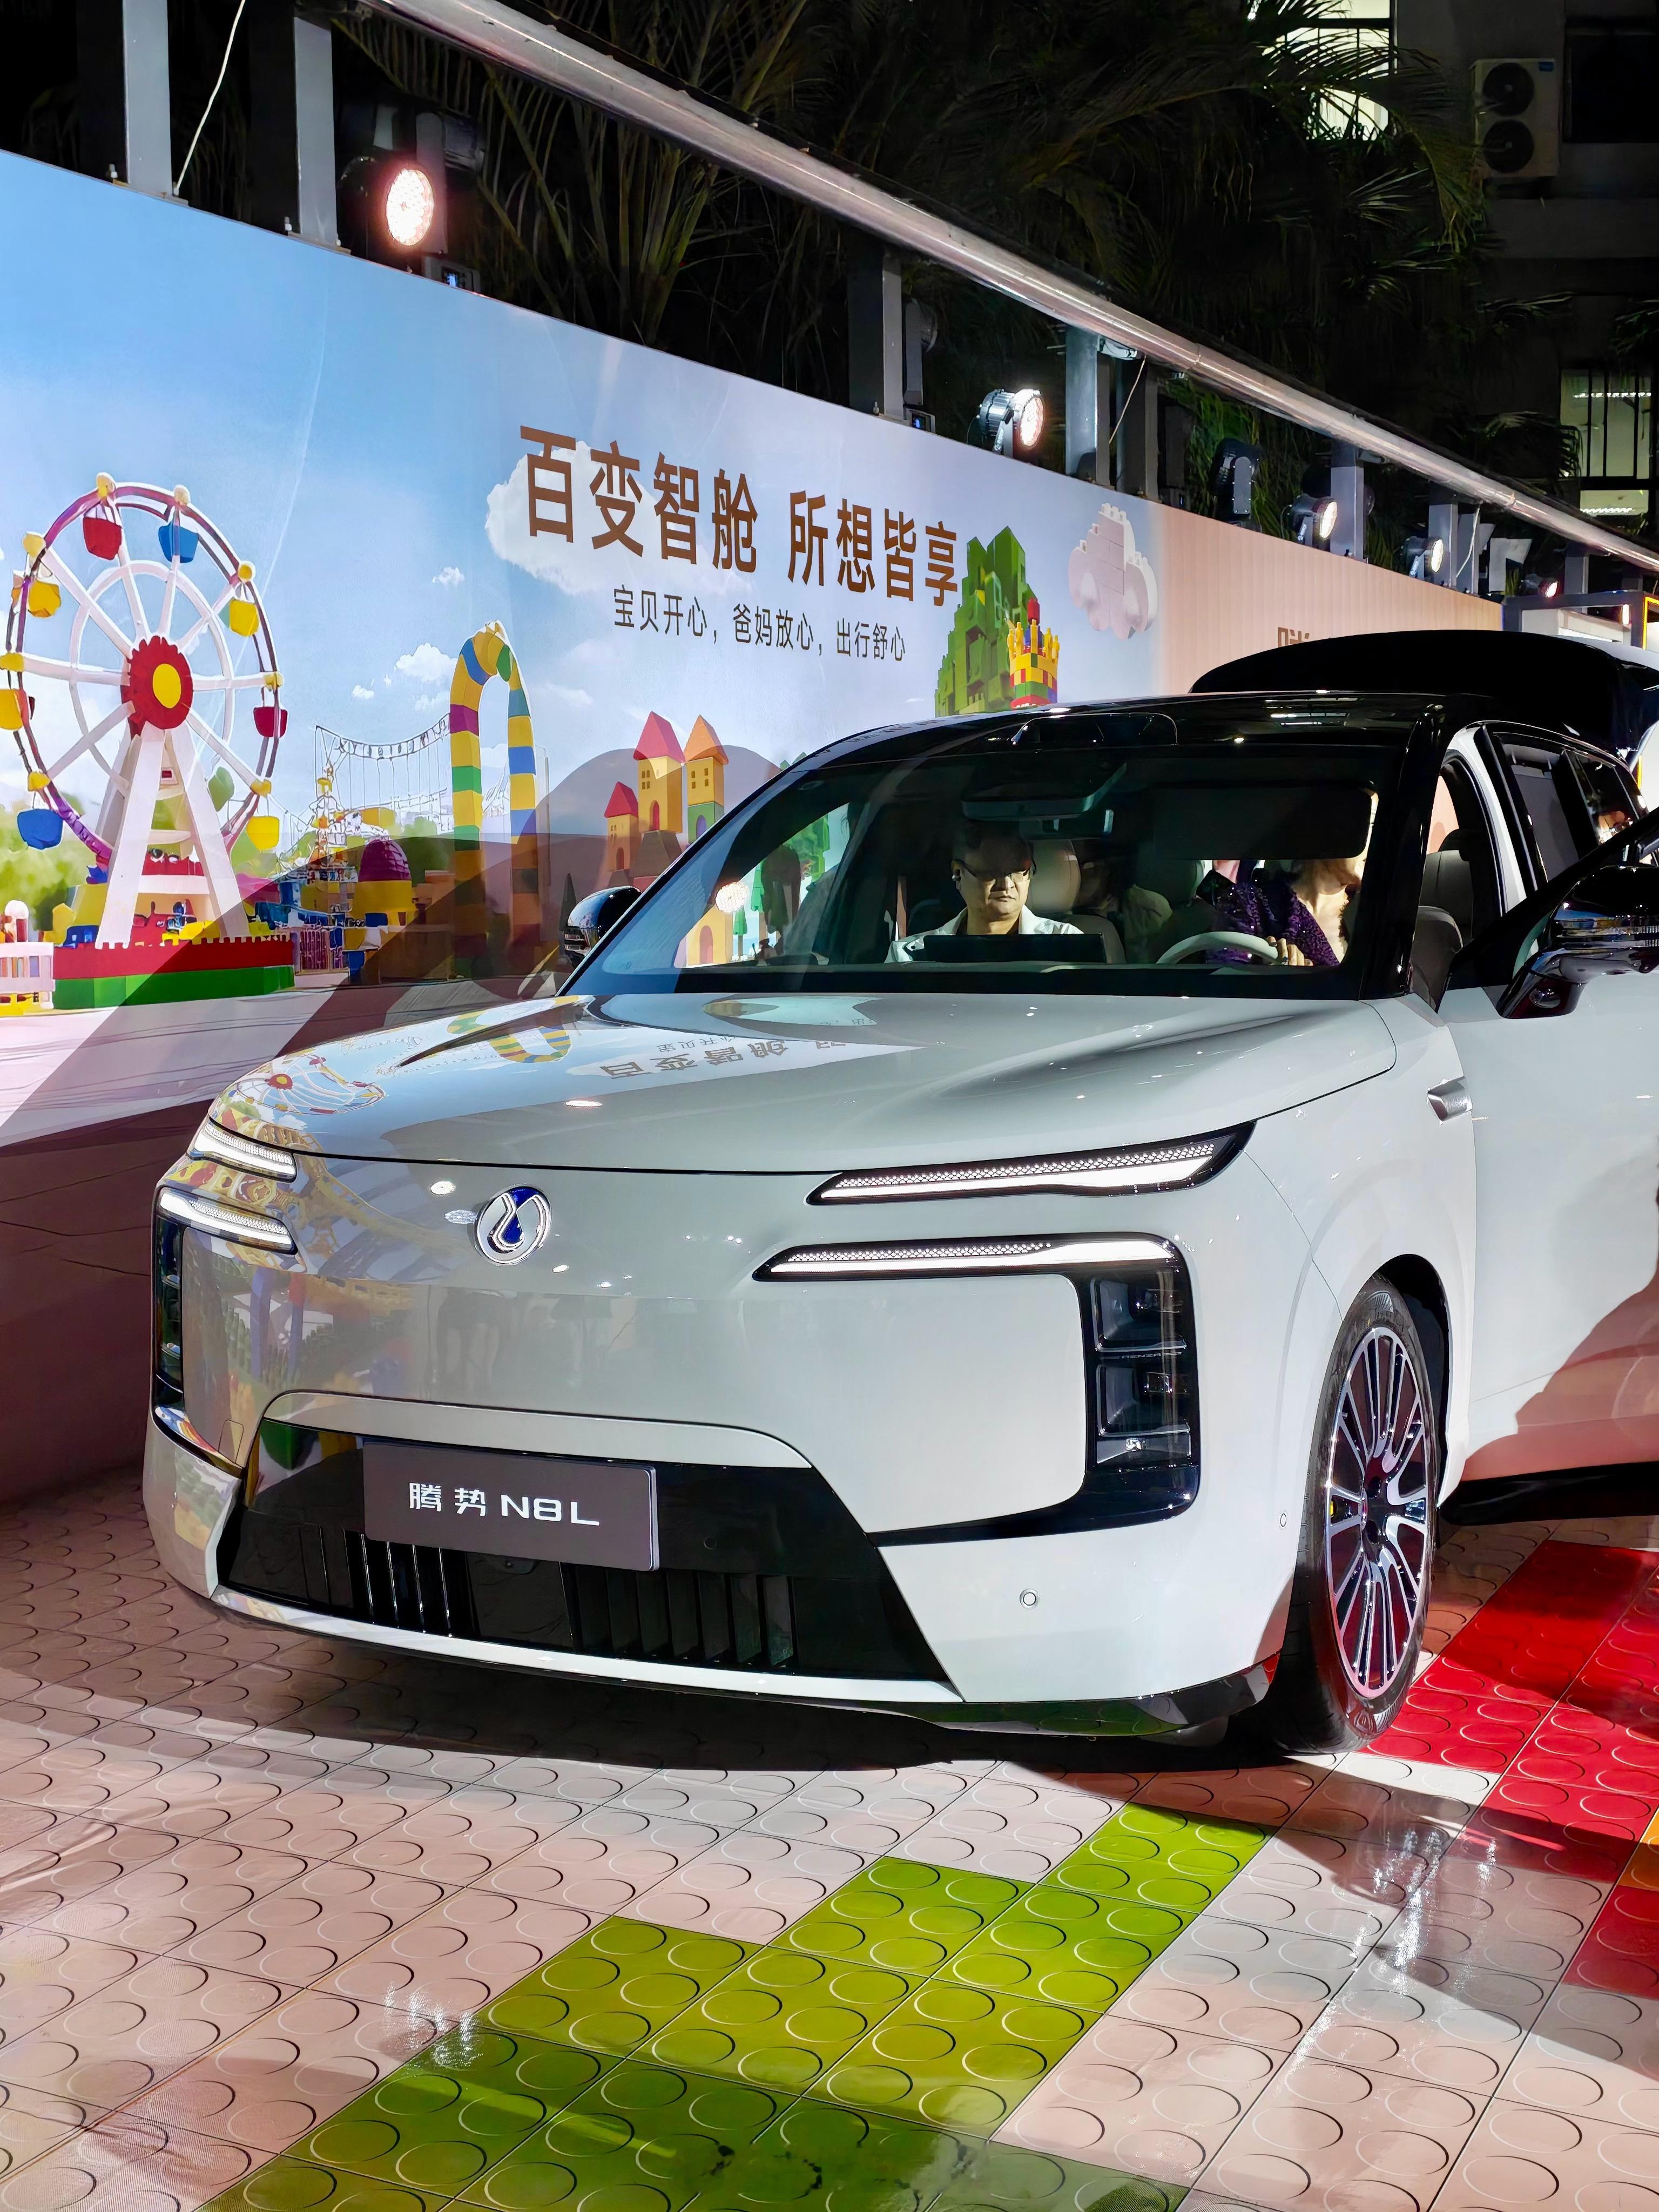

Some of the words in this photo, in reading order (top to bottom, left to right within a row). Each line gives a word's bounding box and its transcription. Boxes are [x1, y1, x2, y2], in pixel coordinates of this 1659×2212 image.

[520, 425, 758, 573] 百变智舱
[787, 490, 958, 606] 所想皆享
[613, 584, 906, 662] 宝贝开心，爸妈放心，出行舒心
[409, 1482, 487, 1517] 腾势
[501, 1494, 600, 1527] N8L
